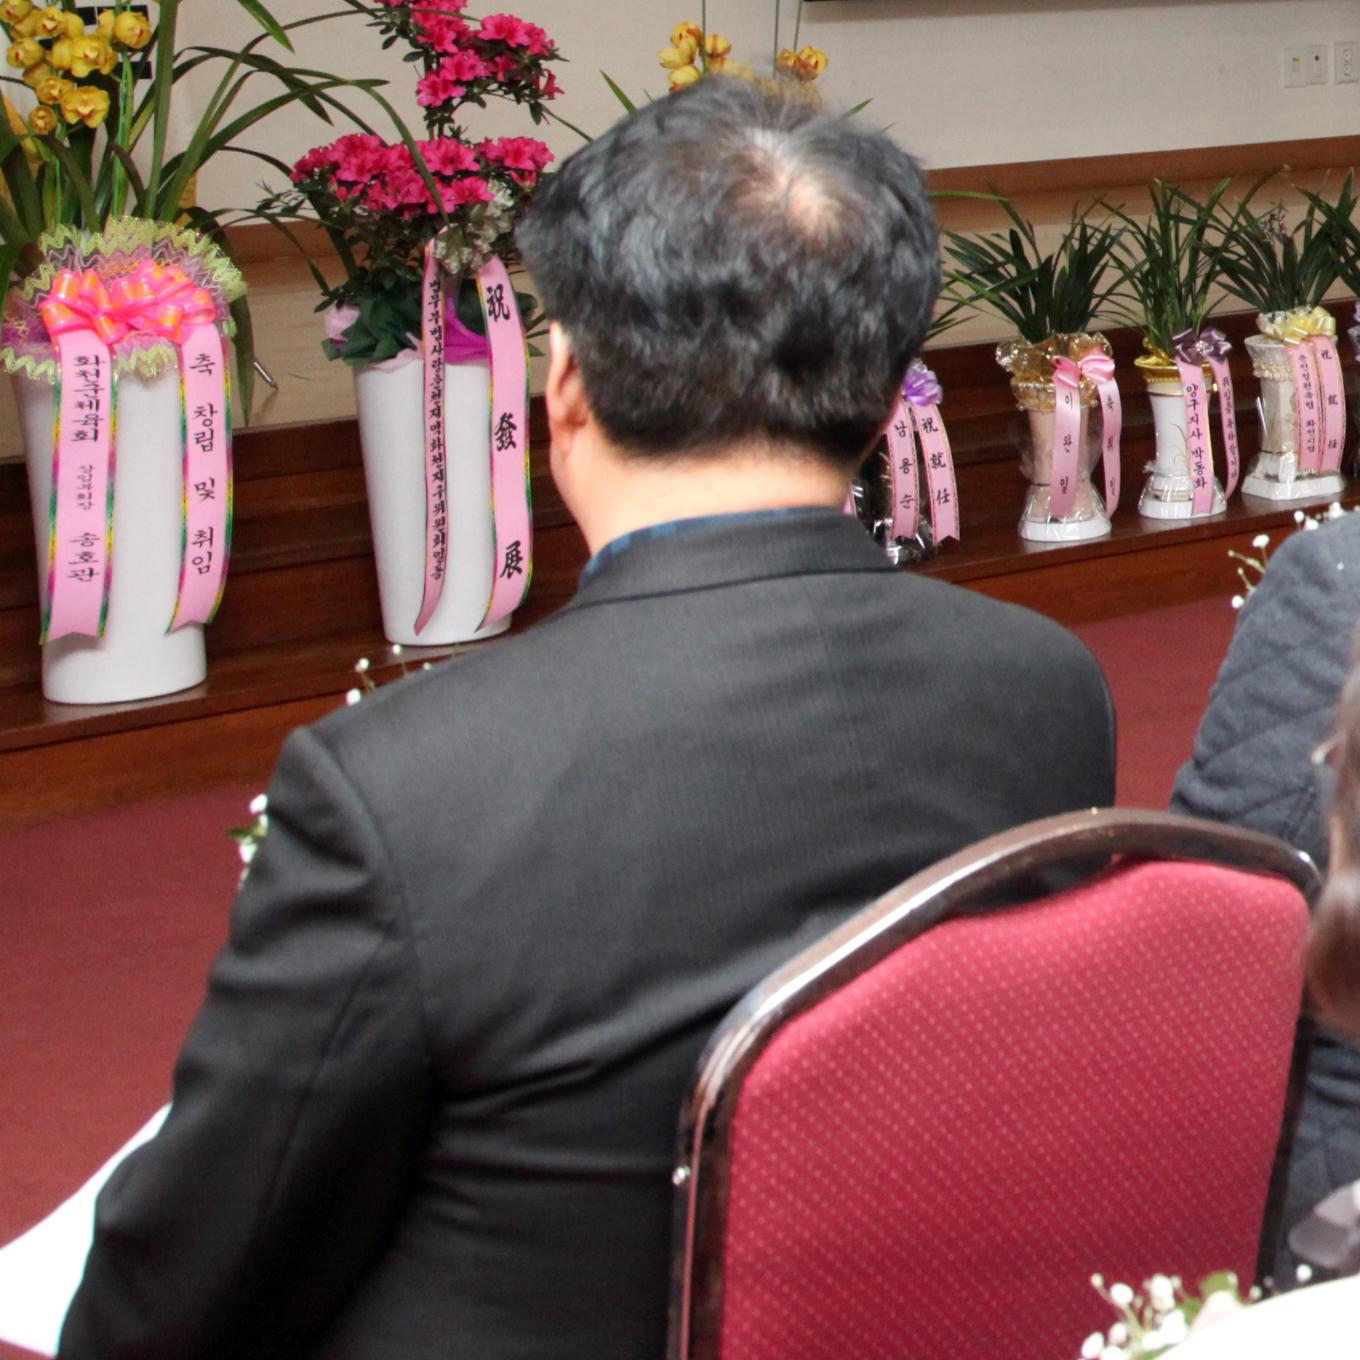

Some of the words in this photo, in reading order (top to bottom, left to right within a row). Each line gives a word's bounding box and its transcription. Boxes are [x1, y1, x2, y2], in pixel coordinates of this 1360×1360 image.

[190, 353, 216, 376] 축
[72, 354, 105, 442] 화천군체육회
[1182, 383, 1203, 440] 양구지사
[194, 402, 218, 453] 창립
[194, 477, 215, 502] 및
[1191, 446, 1208, 489] 박동화
[192, 526, 214, 576] 취임
